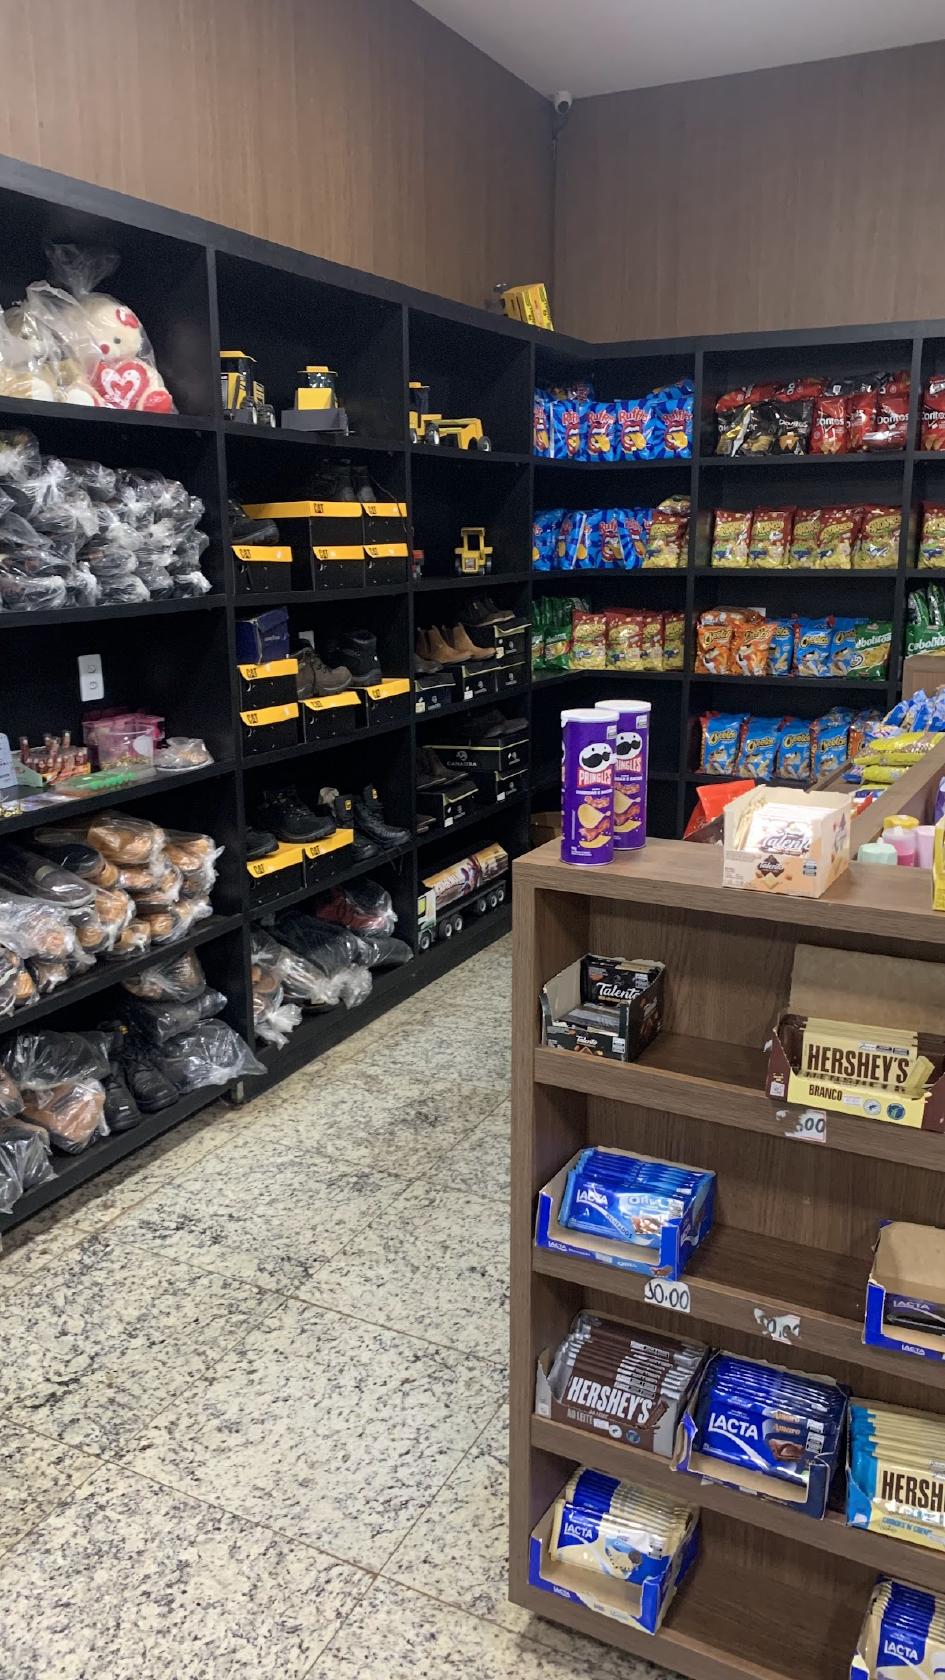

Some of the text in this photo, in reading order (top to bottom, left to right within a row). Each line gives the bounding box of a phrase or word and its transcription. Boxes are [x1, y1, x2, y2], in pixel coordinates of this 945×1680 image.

[313, 502, 324, 514] CAT
[239, 548, 251, 559] CAT
[318, 549, 329, 559] CAT
[246, 667, 257, 678] CAT
[372, 689, 381, 698] CAT
[246, 713, 258, 724] CAT
[578, 768, 612, 786] PRINGLES
[309, 845, 321, 856] CAT
[253, 863, 265, 875] CAT
[807, 1043, 910, 1084] HERSHEY'S
[808, 1084, 843, 1101] BRANCO
[893, 1300, 930, 1310] LACTA
[901, 1344, 926, 1356] LACTA
[566, 1376, 654, 1425] HERSHEY'S
[708, 1412, 759, 1440] LACTA
[881, 1470, 945, 1513] HERSH
[564, 1523, 593, 1539] LACTA
[884, 1640, 919, 1661] LACTA
